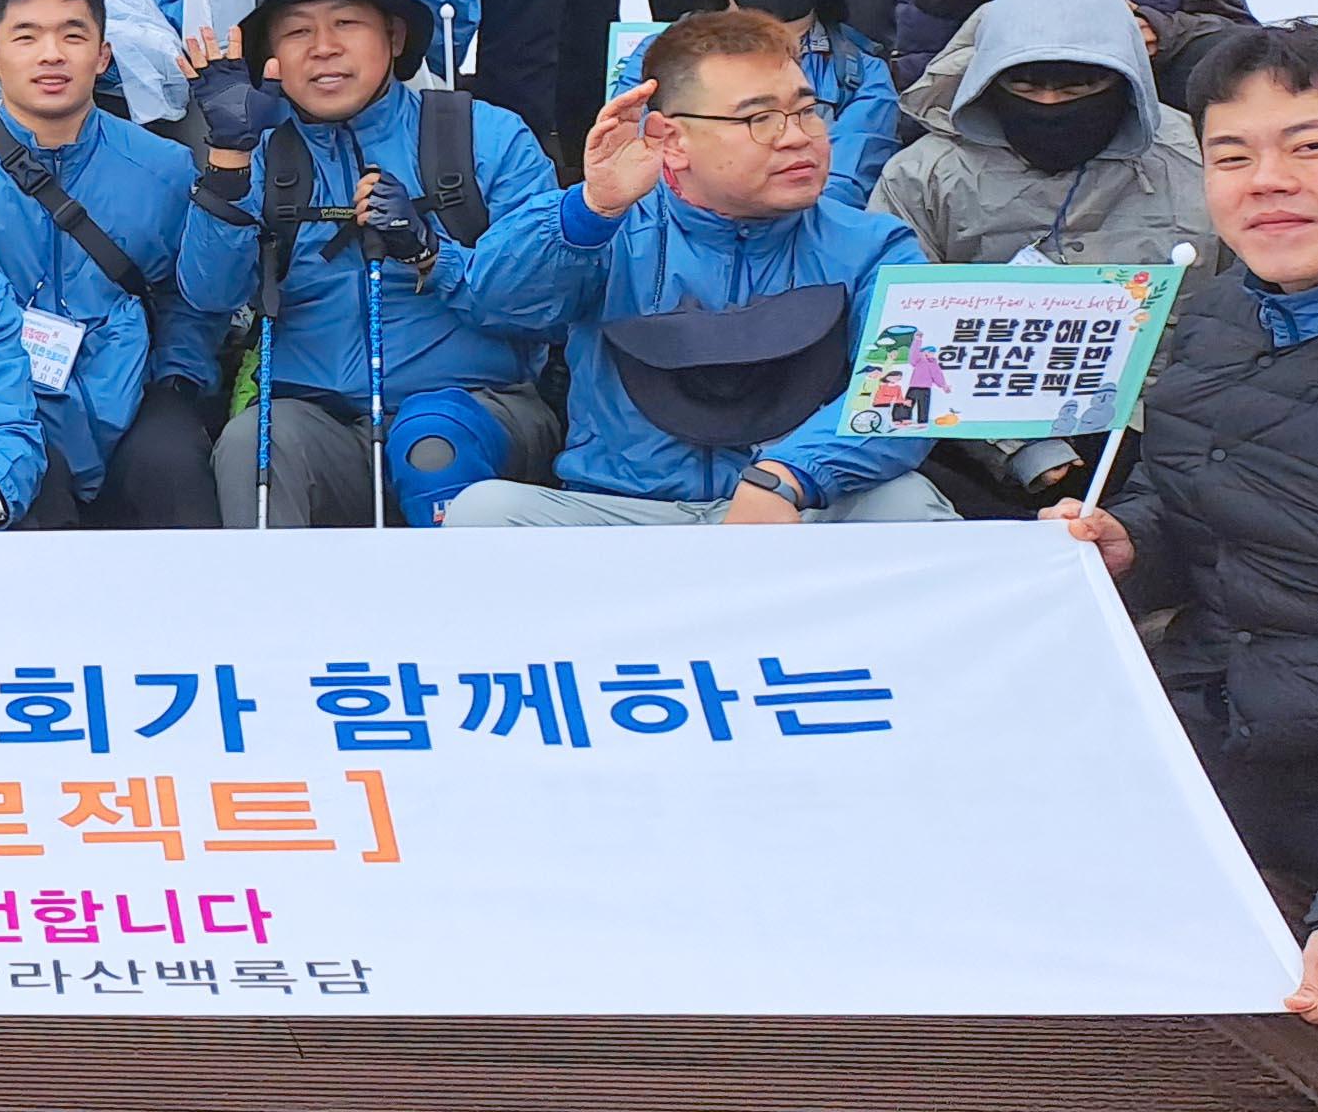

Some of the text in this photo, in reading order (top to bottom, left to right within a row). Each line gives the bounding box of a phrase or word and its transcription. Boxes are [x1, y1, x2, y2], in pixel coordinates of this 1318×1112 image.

[952, 318, 1122, 344] 발달장애인
[937, 345, 1113, 370] 한라산 등반
[972, 372, 1105, 397] 프로젝트
[309, 657, 894, 751] 함께하는
